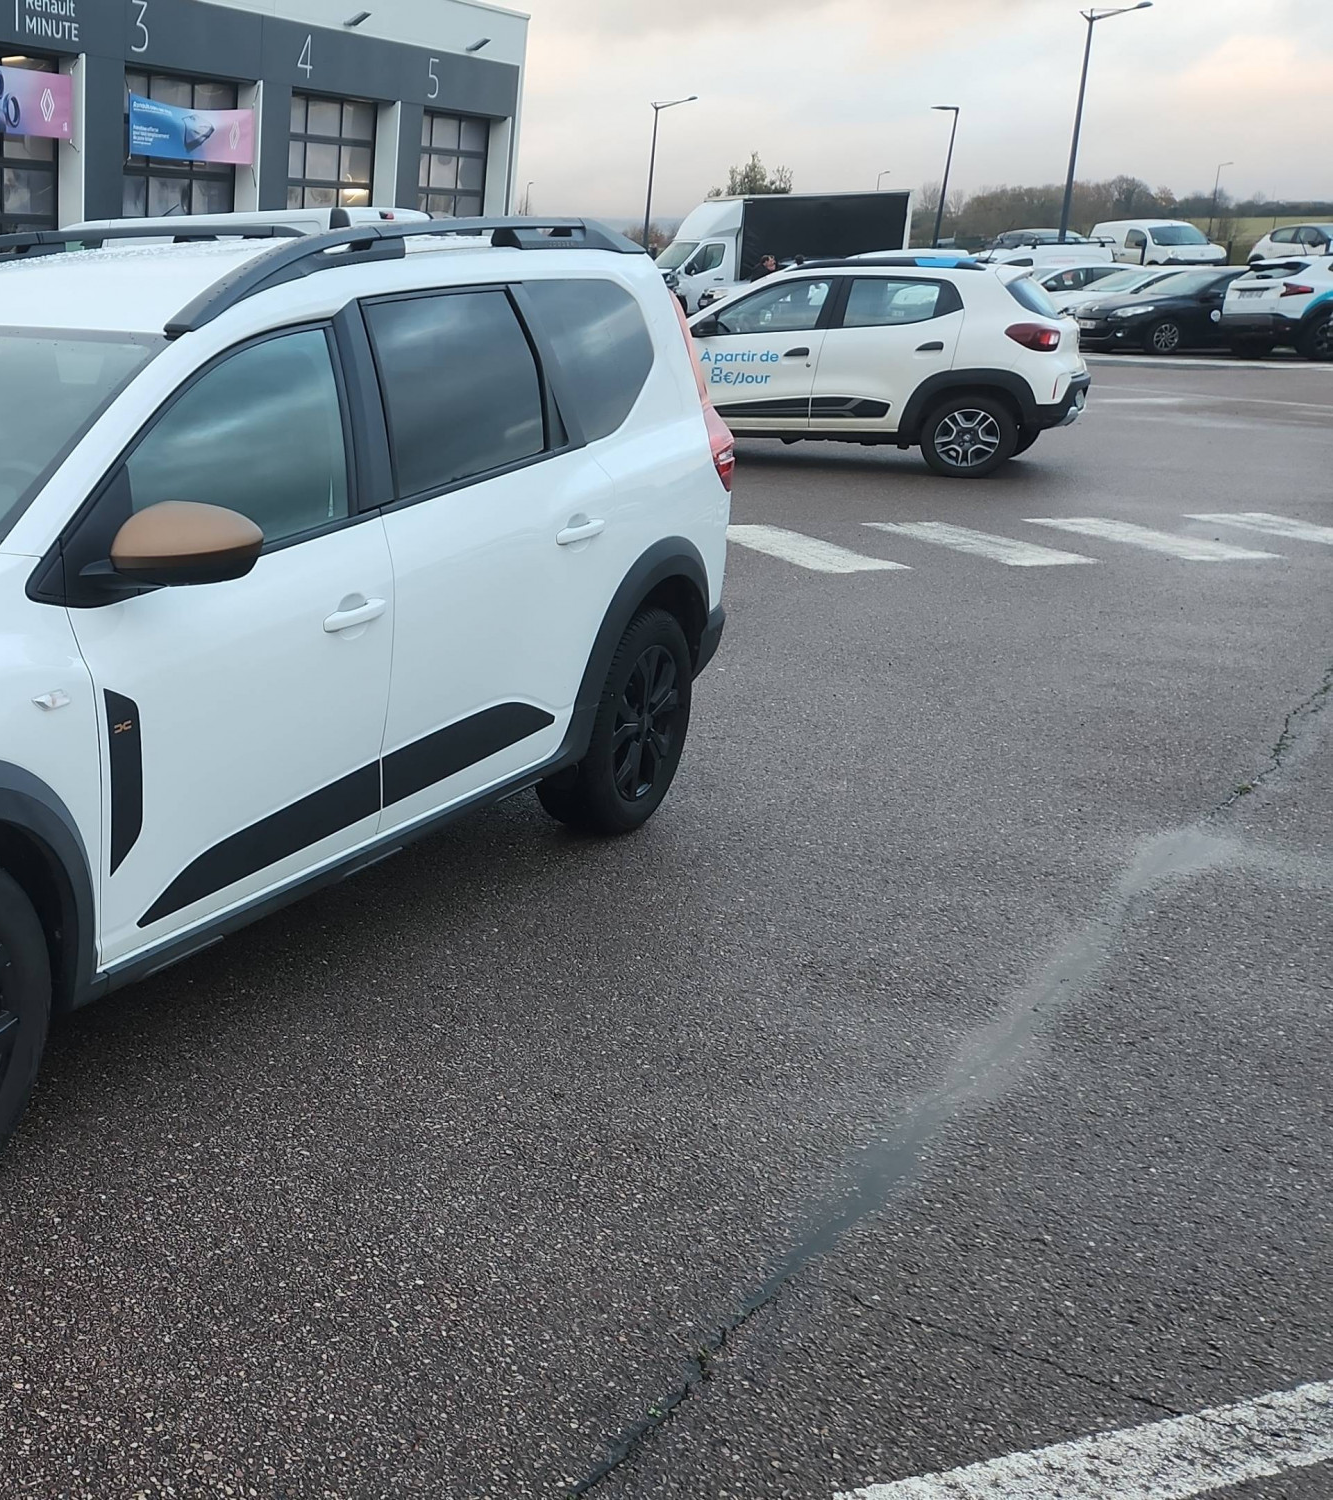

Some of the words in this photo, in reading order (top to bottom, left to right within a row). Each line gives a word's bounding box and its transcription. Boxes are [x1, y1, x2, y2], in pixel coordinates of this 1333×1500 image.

[25, 15, 80, 42] MINUTE
[130, 0, 149, 52] 3
[297, 34, 313, 79] 4
[427, 57, 440, 98] 5
[700, 347, 711, 362] À
[714, 350, 757, 365] partir
[759, 350, 779, 363] de
[710, 366, 771, 386] 8€/Jour
